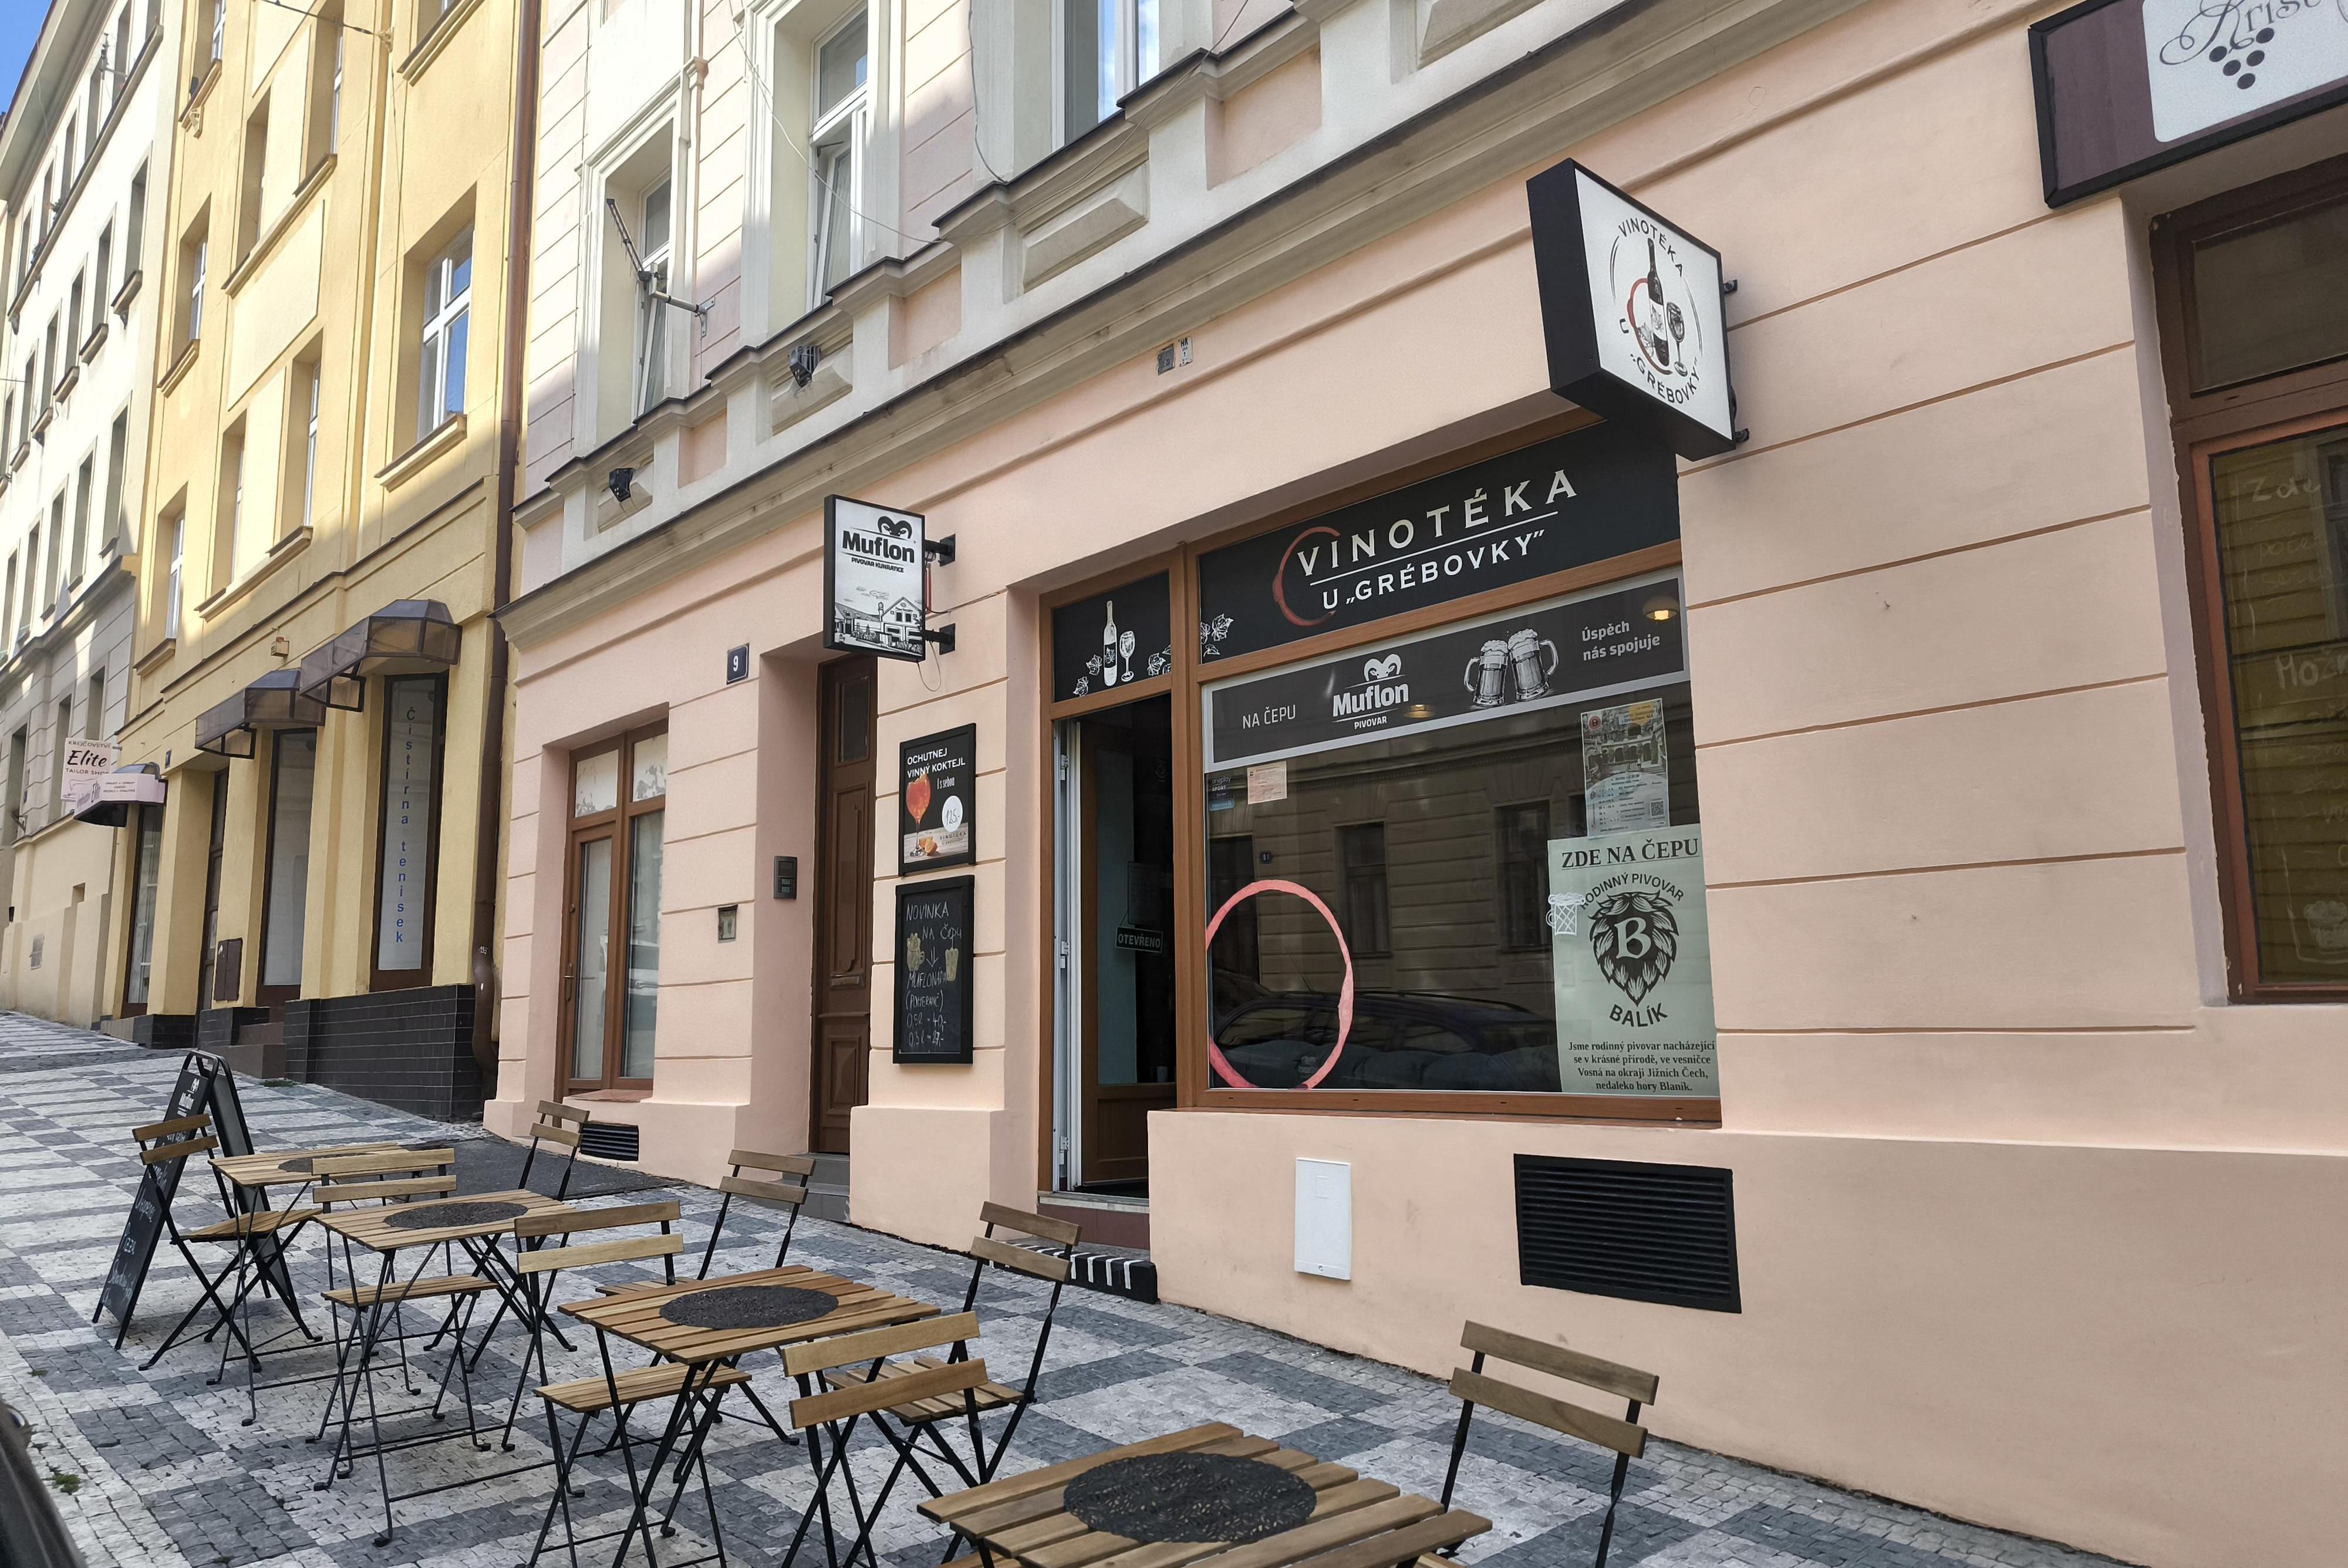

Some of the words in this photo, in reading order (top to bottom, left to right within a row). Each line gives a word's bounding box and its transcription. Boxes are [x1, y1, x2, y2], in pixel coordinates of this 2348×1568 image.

[2160, 0, 2322, 65] Kris
[1618, 218, 1683, 278] VINOTÉKA
[1297, 469, 1577, 577] VINOTÉKA
[842, 530, 915, 564] Muflon
[851, 557, 875, 567] PIVOVAR
[875, 562, 905, 573] KUNRATICE
[1323, 588, 1338, 610] U
[1581, 621, 1630, 642] Úspěch
[1583, 646, 1606, 661] nás
[1610, 633, 1661, 656] spojuje
[733, 655, 738, 672] 9
[1332, 683, 1409, 717] Muflon
[1243, 714, 1260, 729] NA
[1264, 704, 1296, 724] ČEPU
[1354, 716, 1387, 730] PIVOVAR
[68, 750, 107, 767] Elite
[907, 747, 947, 765] OCHUTNEJ
[907, 763, 930, 778] VINNÝ
[932, 757, 966, 773] KOKTEJL
[1562, 849, 1602, 868] ZDE
[1607, 845, 1637, 864] NA
[1641, 838, 1699, 860] ČEPU
[396, 841, 407, 943] tenisek
[1632, 874, 1684, 901] PIVOVAR
[906, 902, 949, 921] NOVINKA
[922, 926, 935, 940] NA
[1118, 933, 1160, 948] OTEVŘENO
[1614, 917, 1652, 959] B
[1609, 1003, 1668, 1027] BALÍK
[1568, 1041, 1590, 1051] Jsme
[1591, 1041, 1625, 1053] rodinný
[1627, 1042, 1661, 1053] pivovar
[1663, 1041, 1715, 1052] nacházející
[1591, 1055, 1620, 1064] krásné
[1622, 1054, 1658, 1066] přírodě,
[1672, 1054, 1711, 1064] vesničce
[1577, 1067, 1603, 1077] Vosná
[1618, 1068, 1645, 1079] okraji
[1647, 1068, 1679, 1078] Jižních
[1681, 1066, 1709, 1079] Čech,
[1595, 1081, 1634, 1090] nedaleko
[1637, 1081, 1657, 1092] hory
[1660, 1081, 1693, 1091] Blaník.
